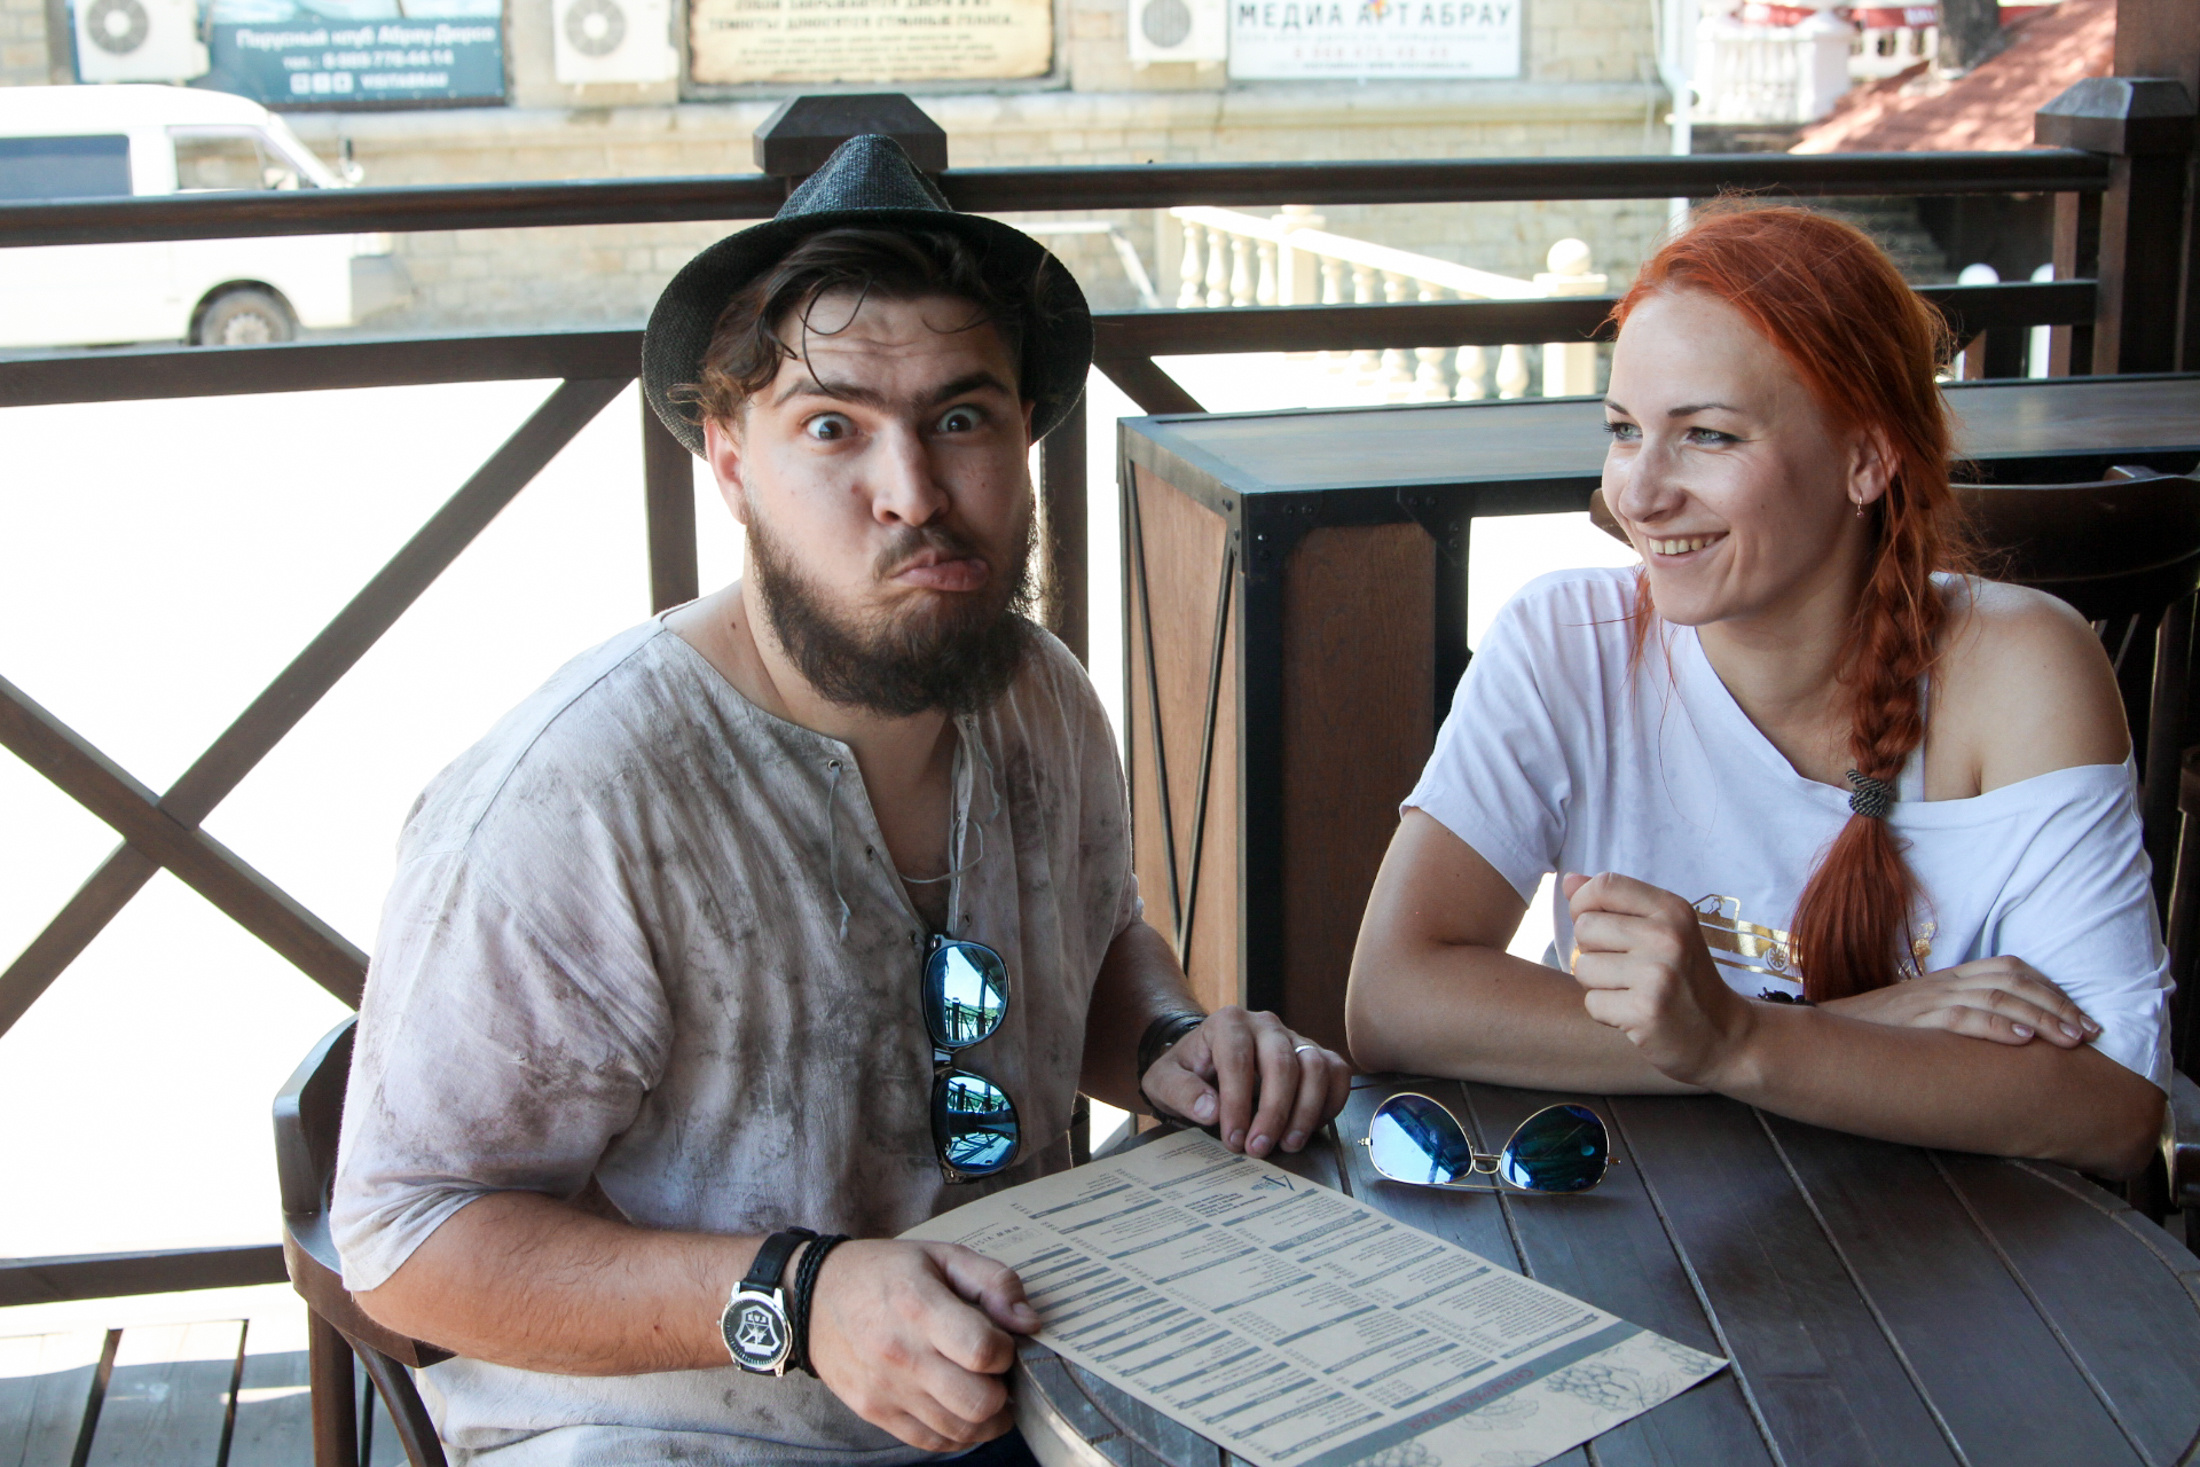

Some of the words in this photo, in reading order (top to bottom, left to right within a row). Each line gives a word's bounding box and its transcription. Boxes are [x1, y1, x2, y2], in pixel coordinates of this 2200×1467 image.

[786, 15, 870, 30] ДОНОСЯТСЯ
[878, 14, 950, 29] СТРАННЫЕ
[1238, 4, 1342, 30] МЕДИА
[1357, 4, 1407, 26] АРТ
[1421, 4, 1511, 26] АБРАУ
[235, 28, 328, 51] Парусный
[331, 26, 375, 48] клуб
